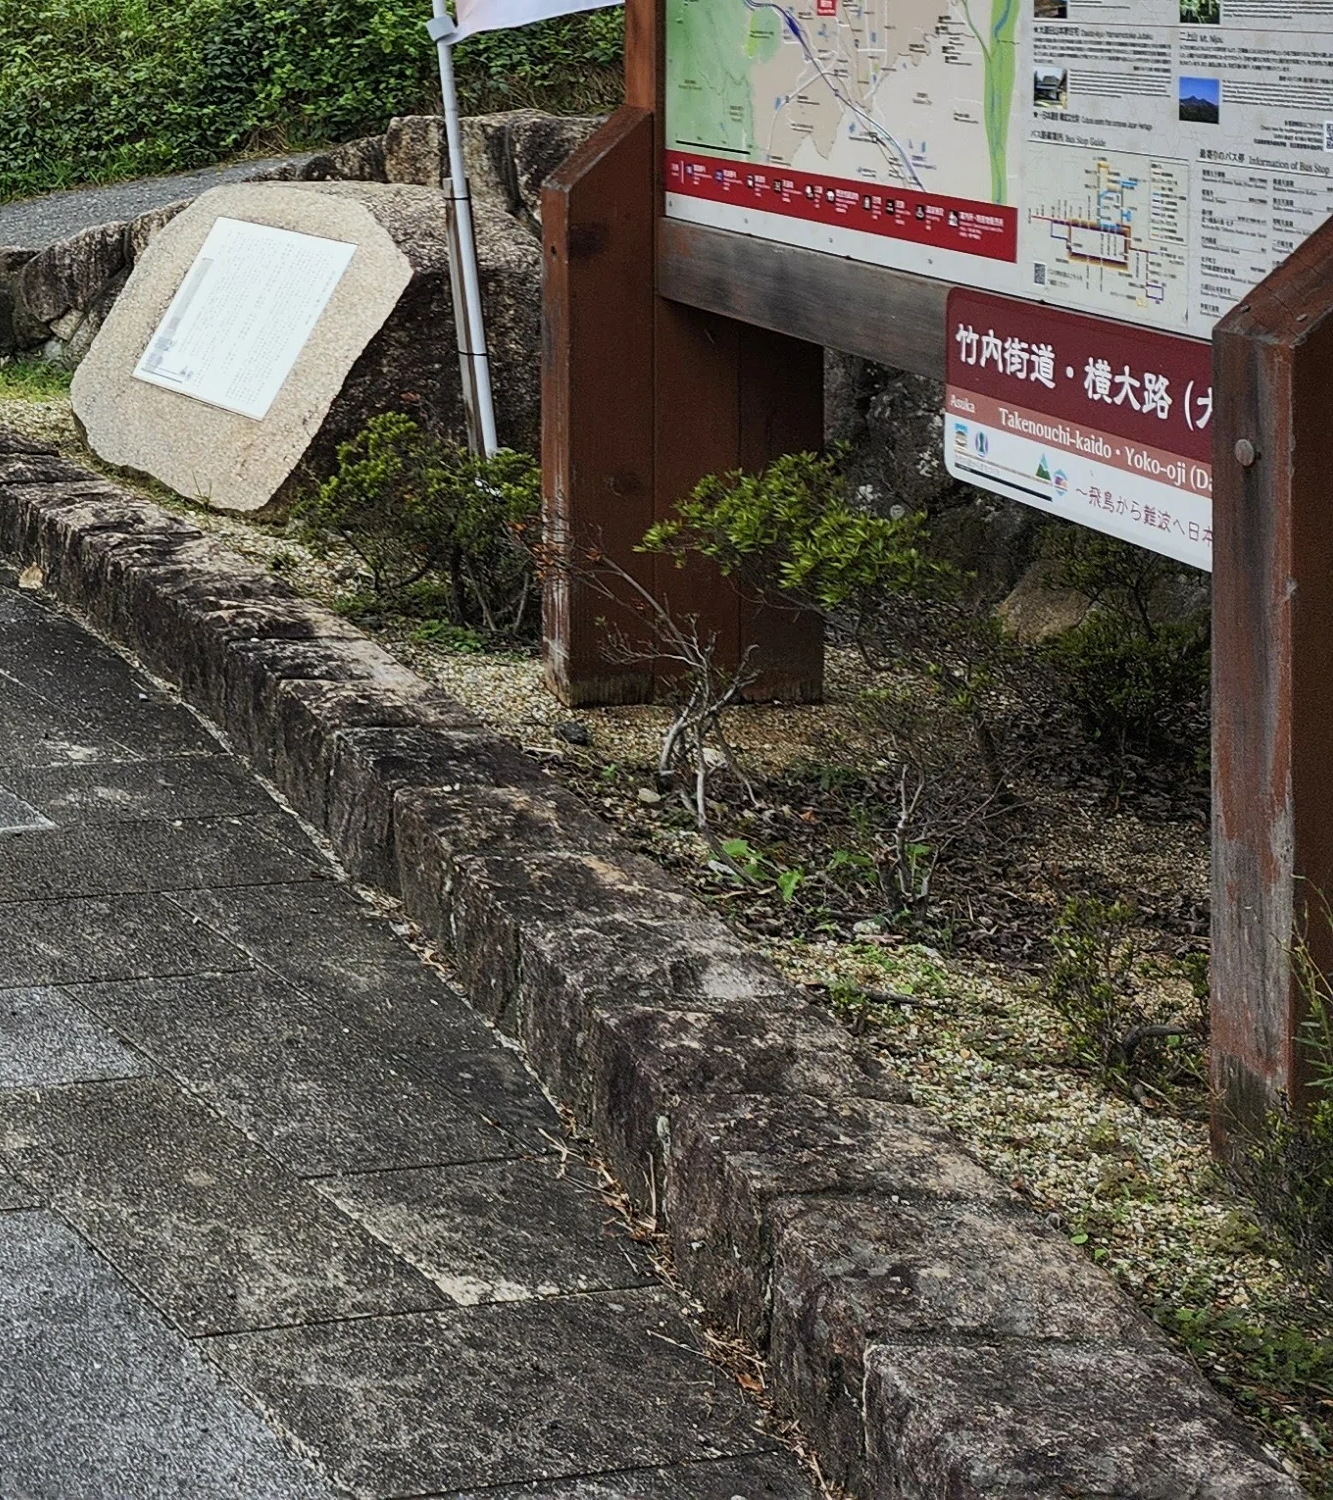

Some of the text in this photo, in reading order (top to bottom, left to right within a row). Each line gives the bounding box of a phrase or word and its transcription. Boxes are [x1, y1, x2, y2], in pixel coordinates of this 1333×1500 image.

[1248, 155, 1289, 170] Information
[1299, 161, 1313, 173] Bus
[1313, 163, 1330, 175] Stop
